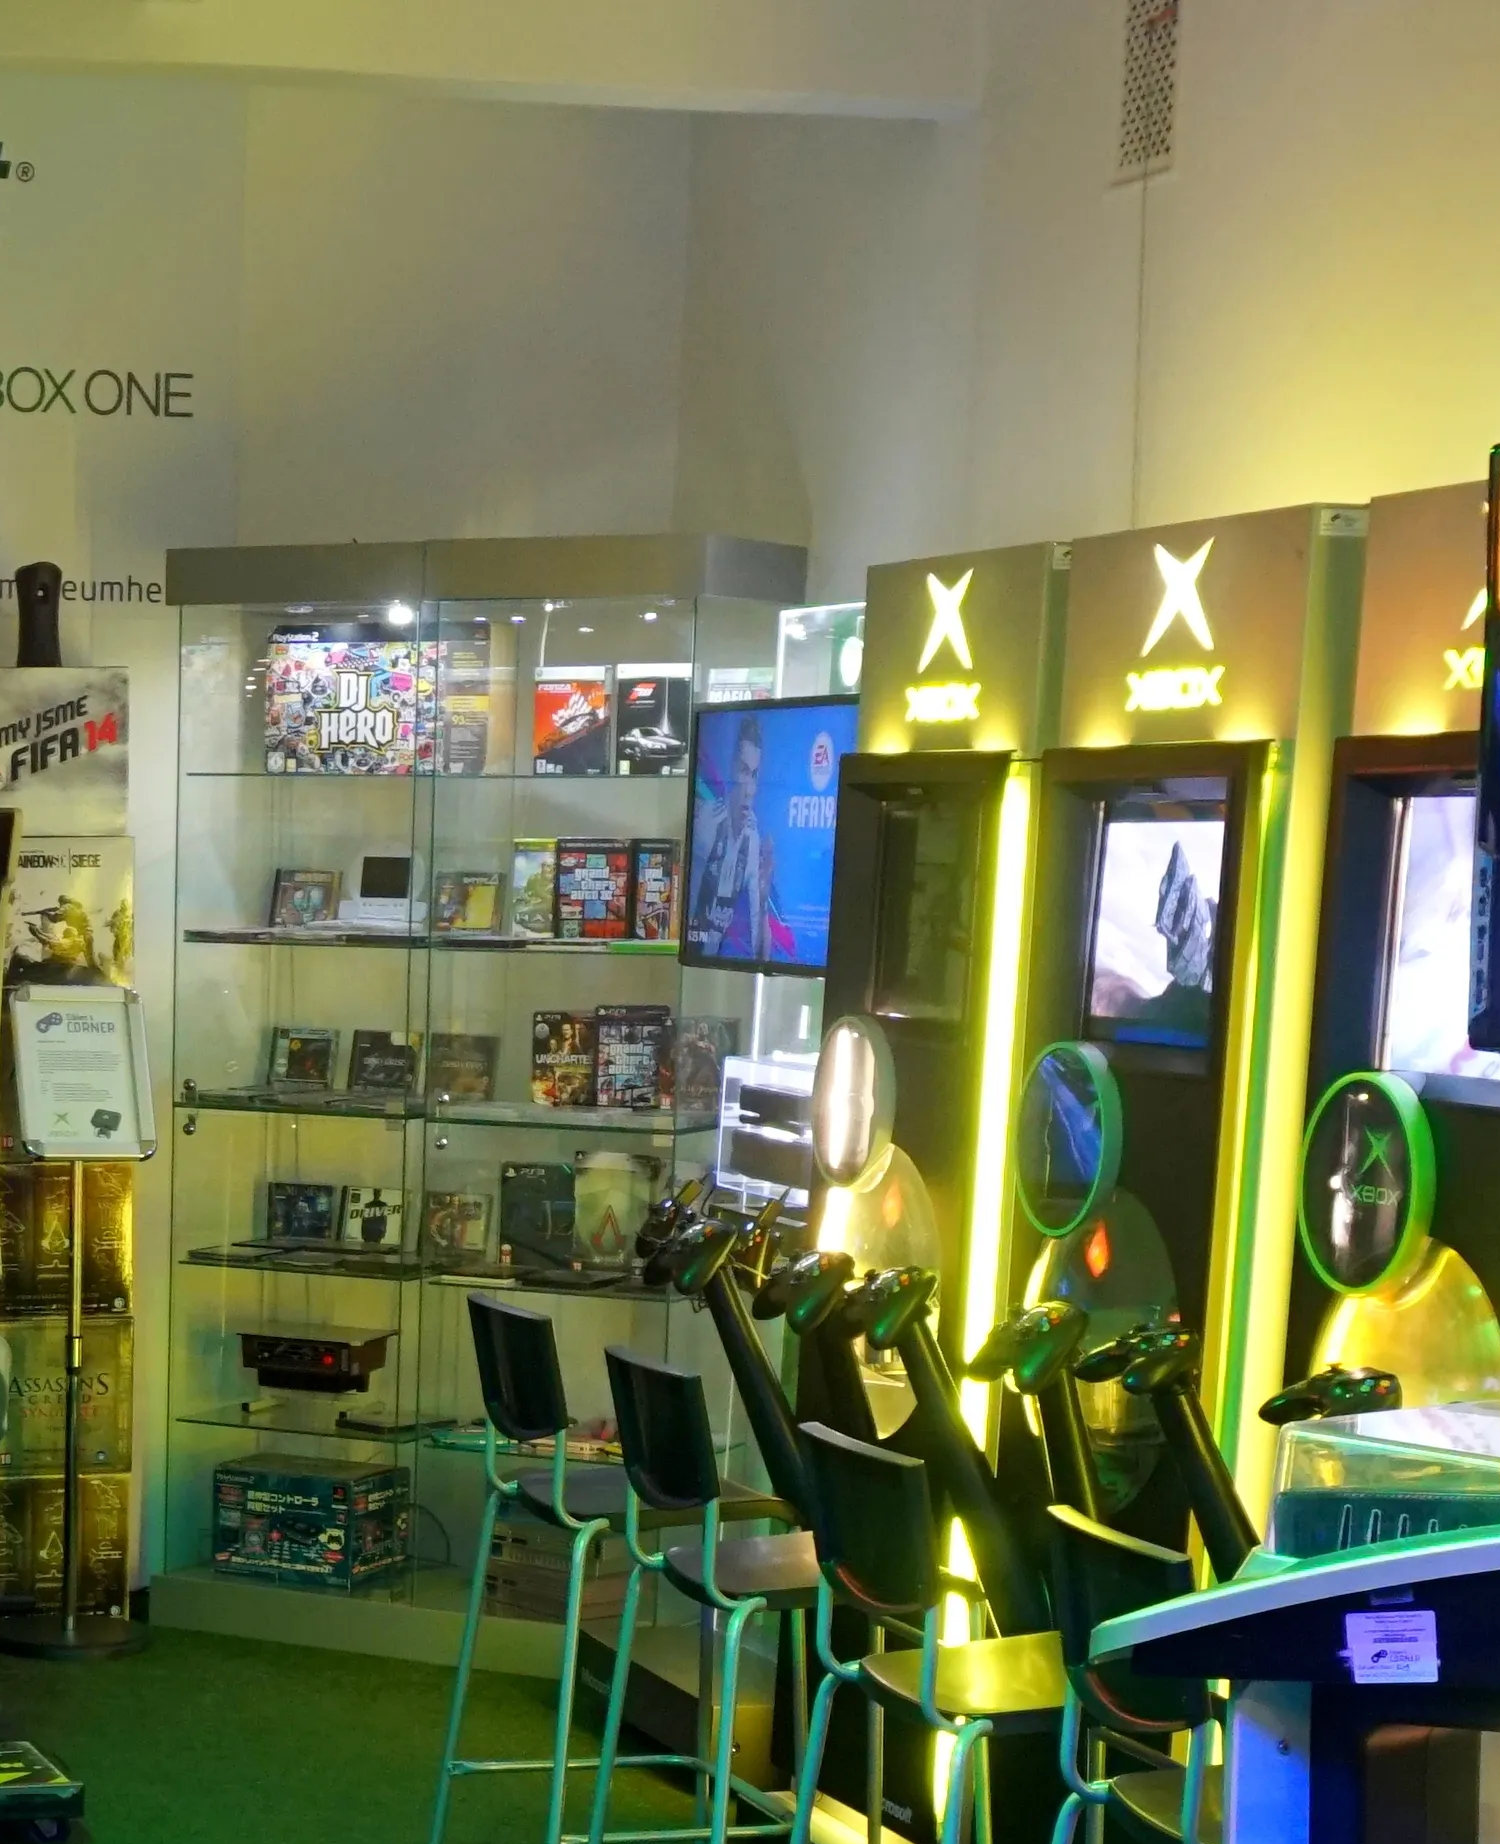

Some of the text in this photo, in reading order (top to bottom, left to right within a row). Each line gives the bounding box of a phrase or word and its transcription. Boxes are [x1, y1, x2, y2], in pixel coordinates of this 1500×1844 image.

[85, 370, 194, 419] ONE
[336, 671, 371, 711] DJ
[904, 682, 982, 724] XBOX
[1123, 664, 1226, 713] XBOX
[10, 711, 119, 782] FIFA 14
[71, 853, 102, 868] SIEGE
[66, 1020, 115, 1035] CORNER
[349, 1203, 404, 1221] DRIVER
[1350, 1183, 1401, 1208] XBOX
